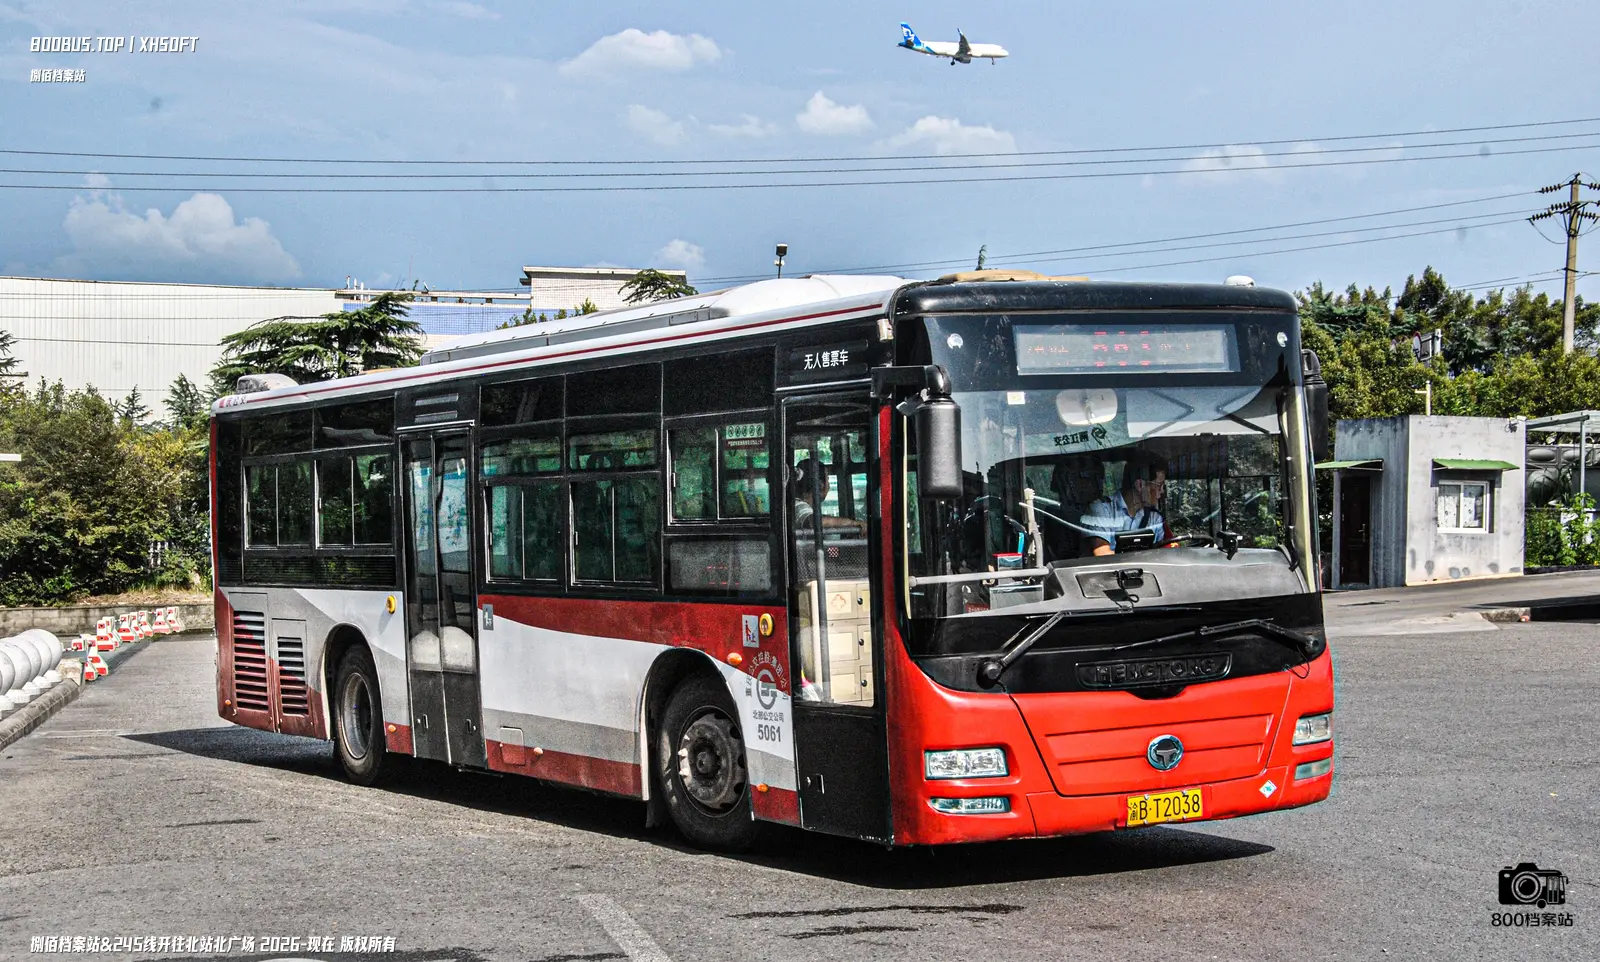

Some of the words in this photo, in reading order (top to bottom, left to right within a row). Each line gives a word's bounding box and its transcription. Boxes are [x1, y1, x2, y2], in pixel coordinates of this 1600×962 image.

[803, 349, 849, 370] 无人售票车
[1094, 659, 1216, 684] HENGTONG
[752, 710, 784, 722] 北部公交公司
[757, 723, 782, 742] 5061
